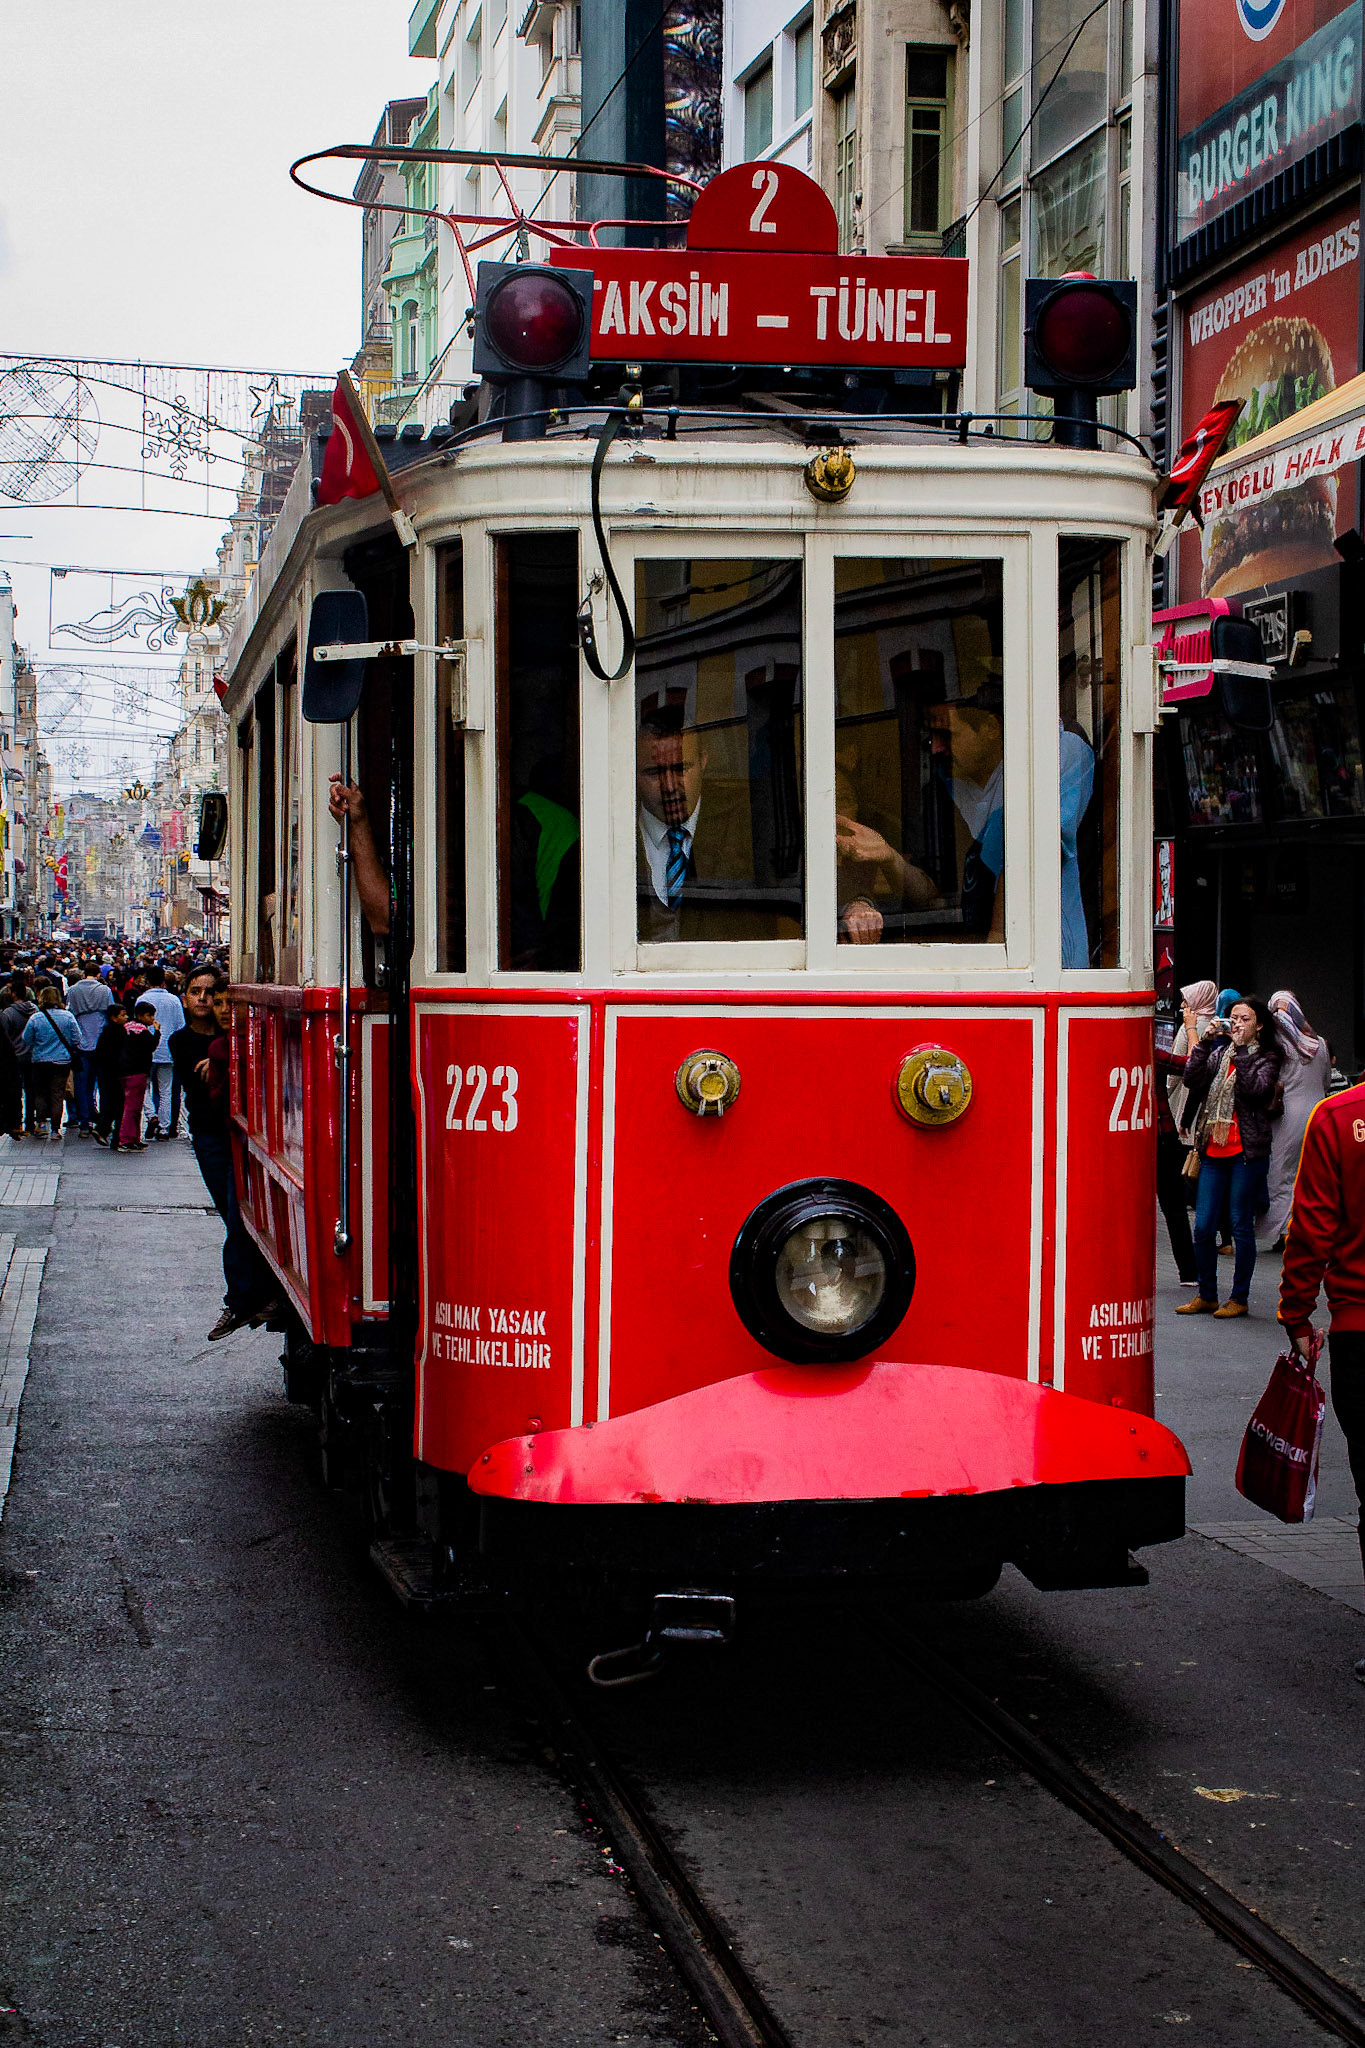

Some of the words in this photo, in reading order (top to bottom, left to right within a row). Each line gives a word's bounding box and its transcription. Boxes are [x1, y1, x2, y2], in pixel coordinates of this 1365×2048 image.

[1189, 94, 1279, 213] BURGER
[1285, 35, 1355, 146] KING
[749, 169, 779, 234] 2
[593, 271, 729, 337] AKSİM
[810, 276, 952, 344] TÜNEL
[1197, 463, 1275, 516] EYOĞLU
[1284, 435, 1345, 480] HALK
[446, 1064, 519, 1132] 223
[1109, 1064, 1153, 1132] 223
[434, 1300, 481, 1332] ASILMAK
[488, 1307, 547, 1336] YASAK
[1089, 1299, 1143, 1328] ASILMAK
[432, 1331, 442, 1358] VE
[445, 1336, 552, 1369] TEHLİKELİDİR
[1081, 1335, 1102, 1361] VE
